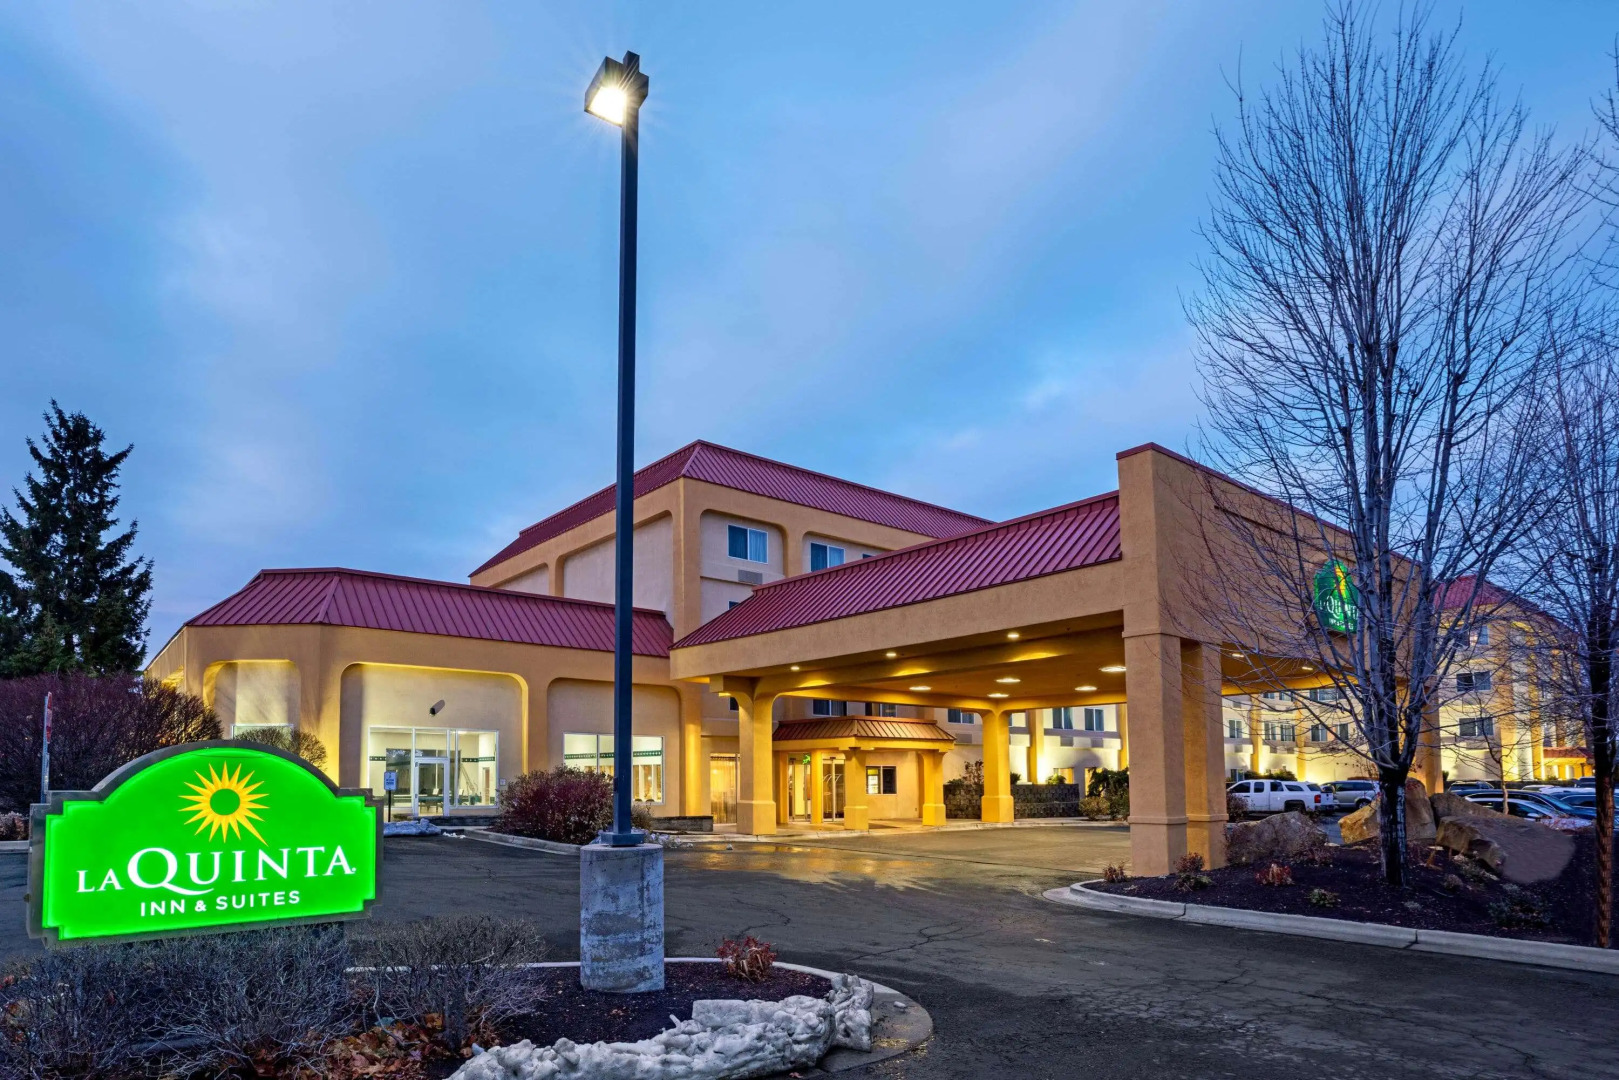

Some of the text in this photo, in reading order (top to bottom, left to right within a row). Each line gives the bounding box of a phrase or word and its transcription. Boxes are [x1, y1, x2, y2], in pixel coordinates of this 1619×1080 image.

[77, 846, 356, 896] LA QUINTA
[140, 890, 300, 917] INN & SUITES
